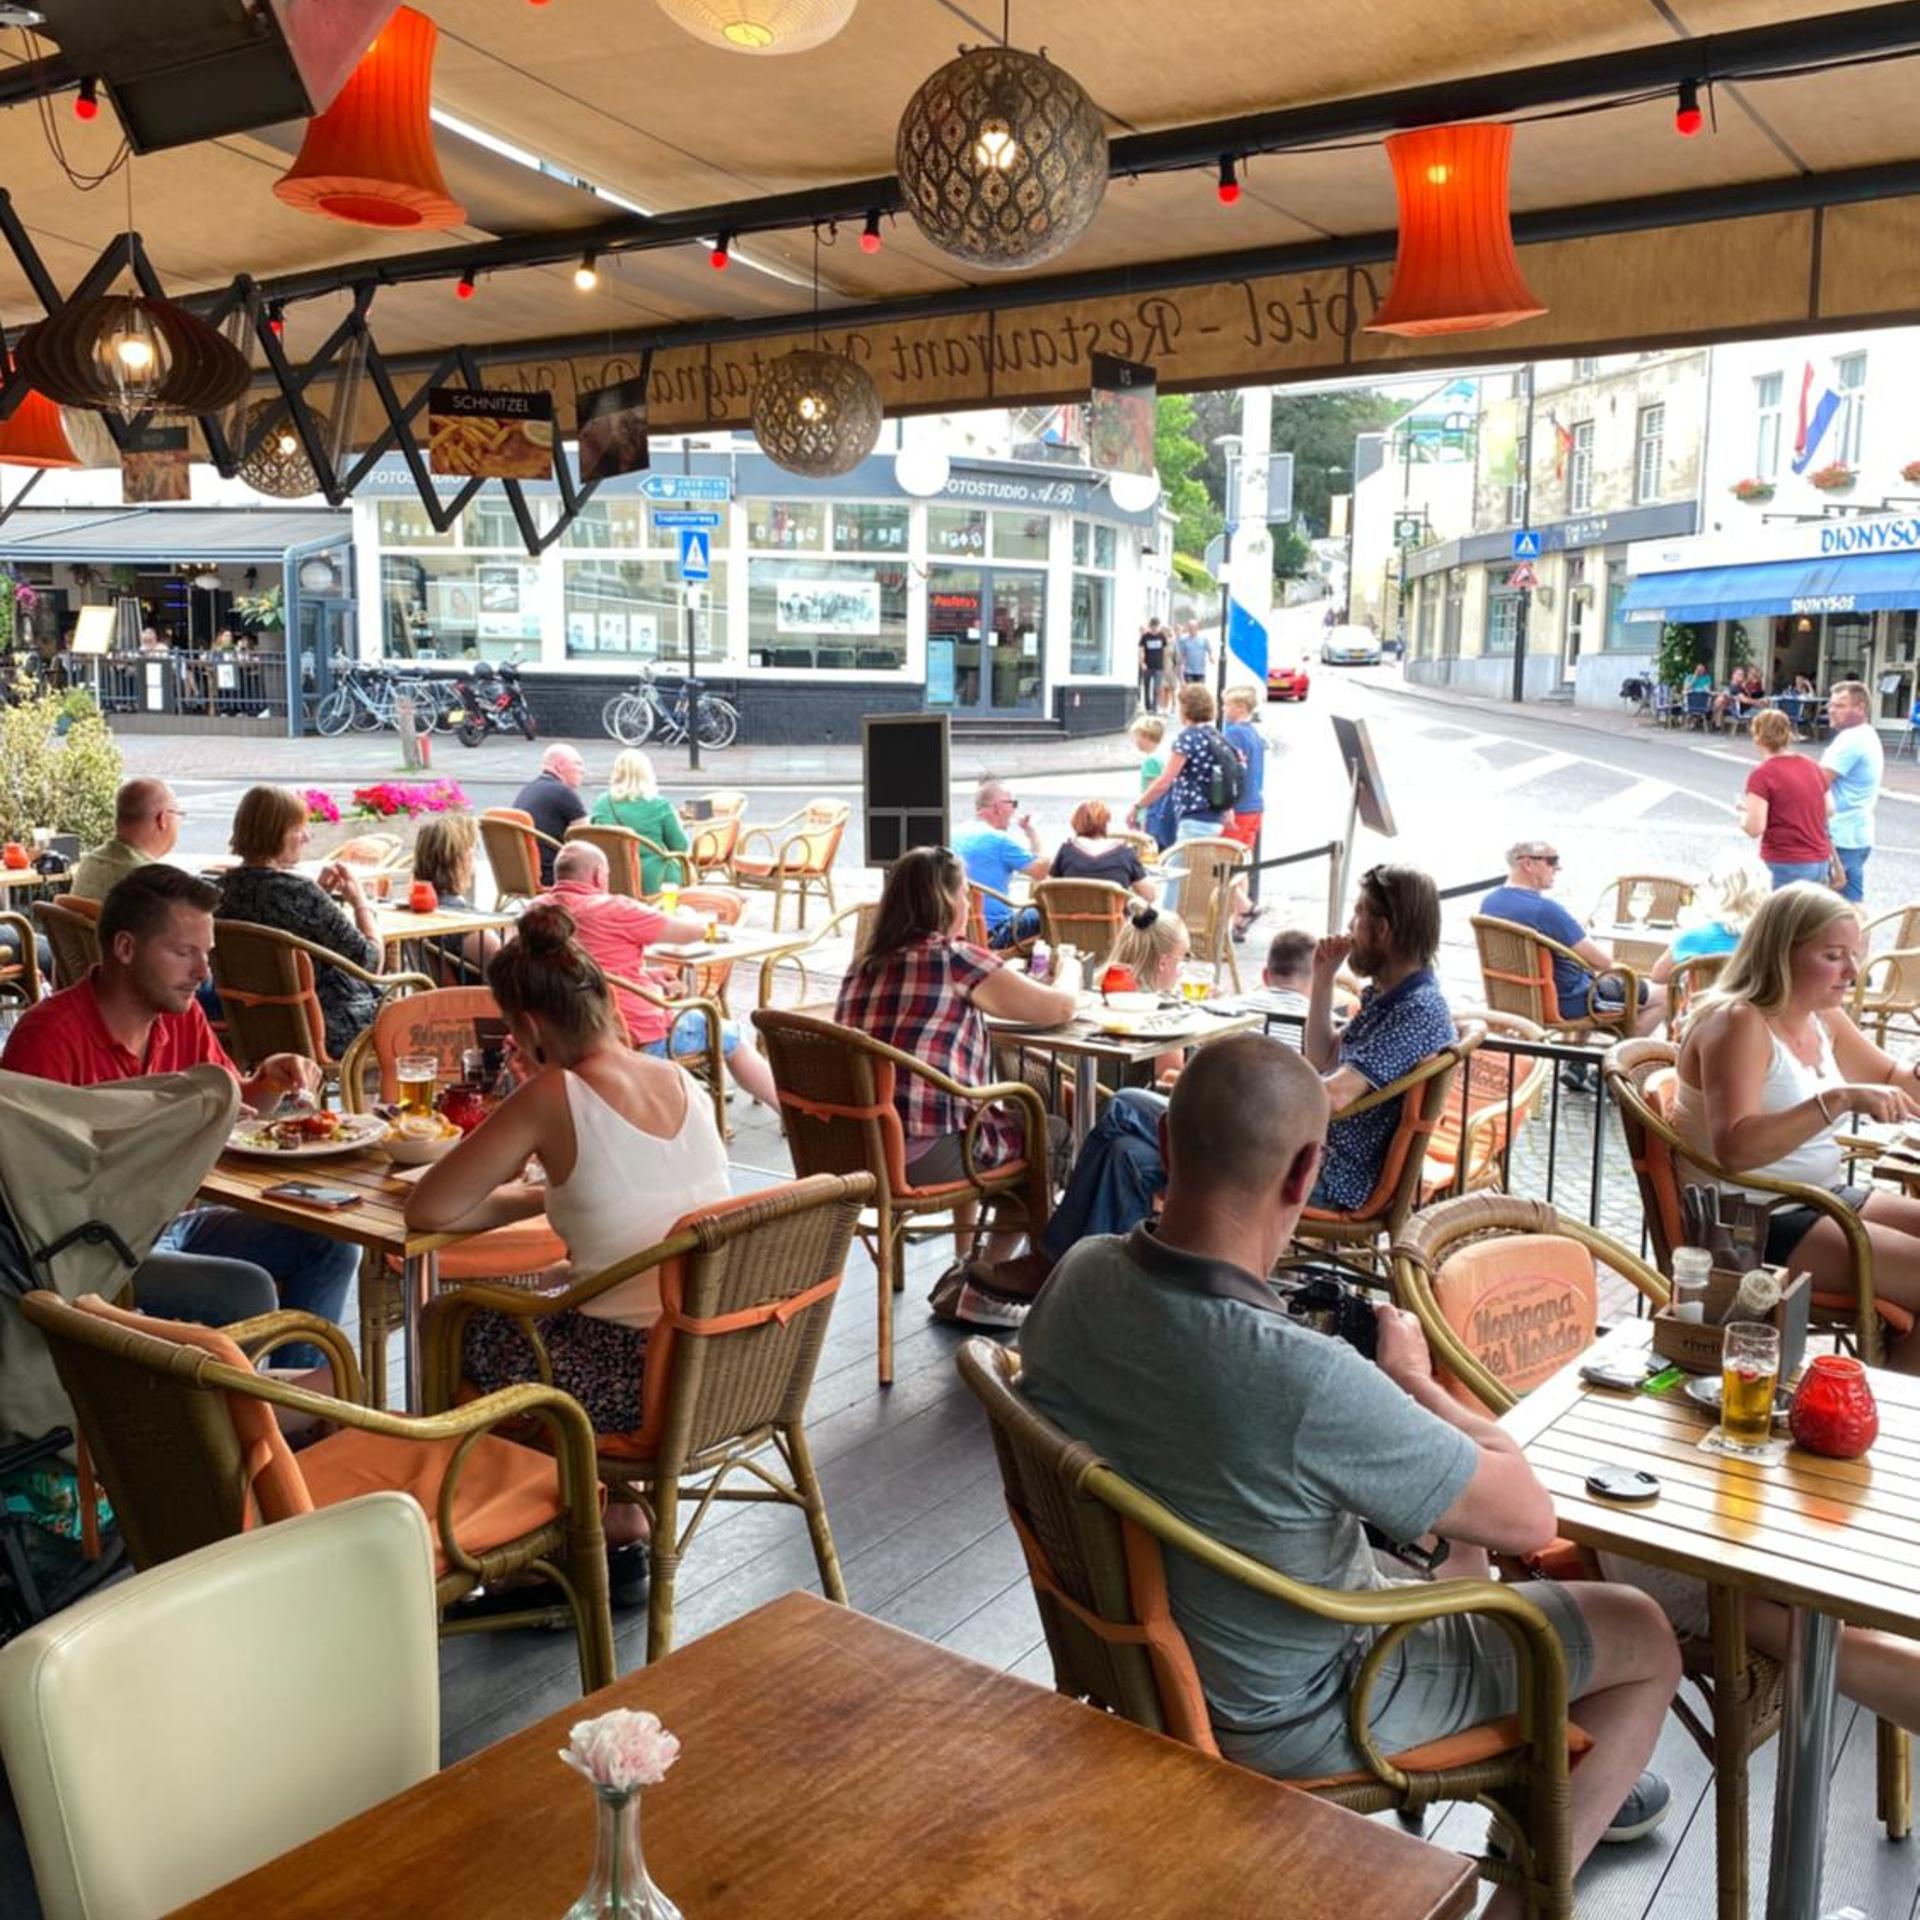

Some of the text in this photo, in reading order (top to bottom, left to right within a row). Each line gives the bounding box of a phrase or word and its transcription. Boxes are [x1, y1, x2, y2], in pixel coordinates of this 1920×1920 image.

[453, 394, 530, 413] SCHNITZEL
[943, 478, 1028, 501] OTOSTUDIO
[1791, 595, 1856, 613] DIONYSOS
